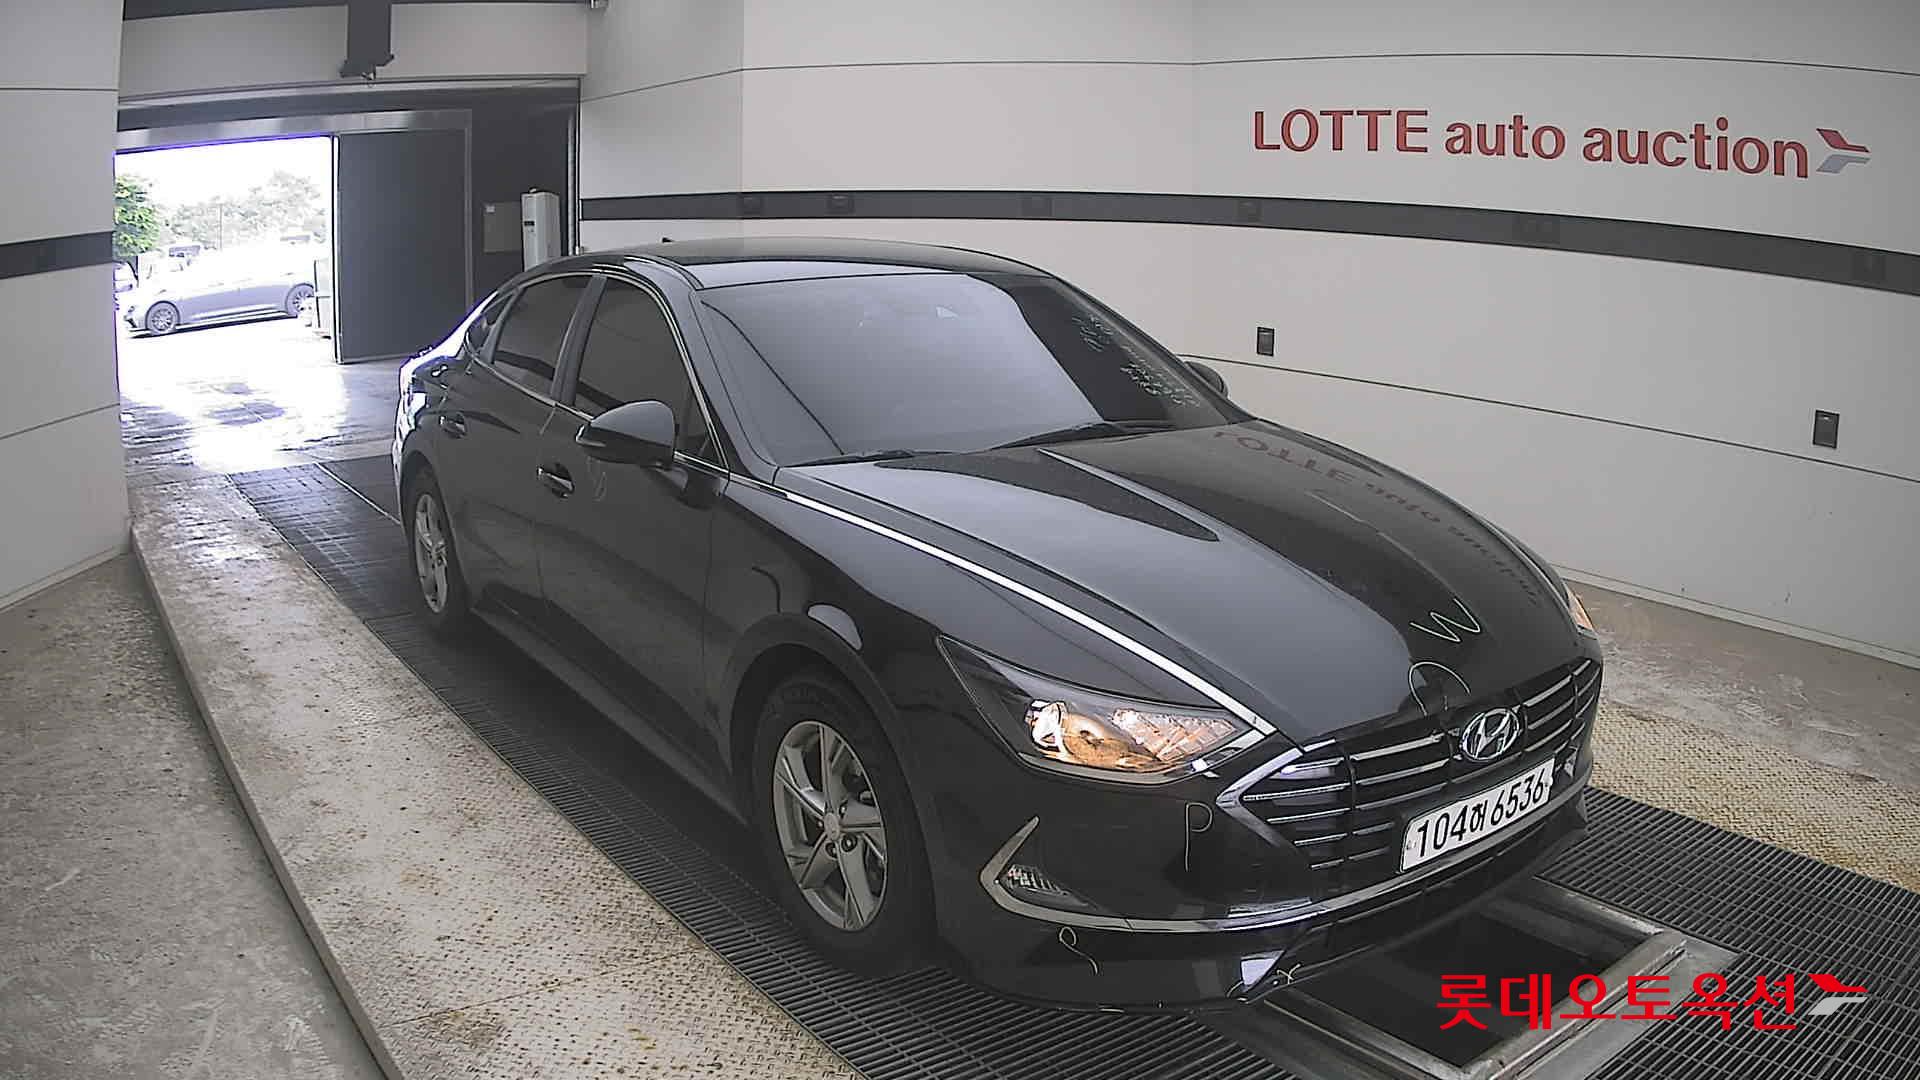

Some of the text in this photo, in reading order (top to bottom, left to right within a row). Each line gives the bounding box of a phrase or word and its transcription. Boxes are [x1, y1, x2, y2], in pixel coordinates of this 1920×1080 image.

[1253, 109, 1809, 179] LOTTE auto auction
[1184, 801, 1213, 873] P
